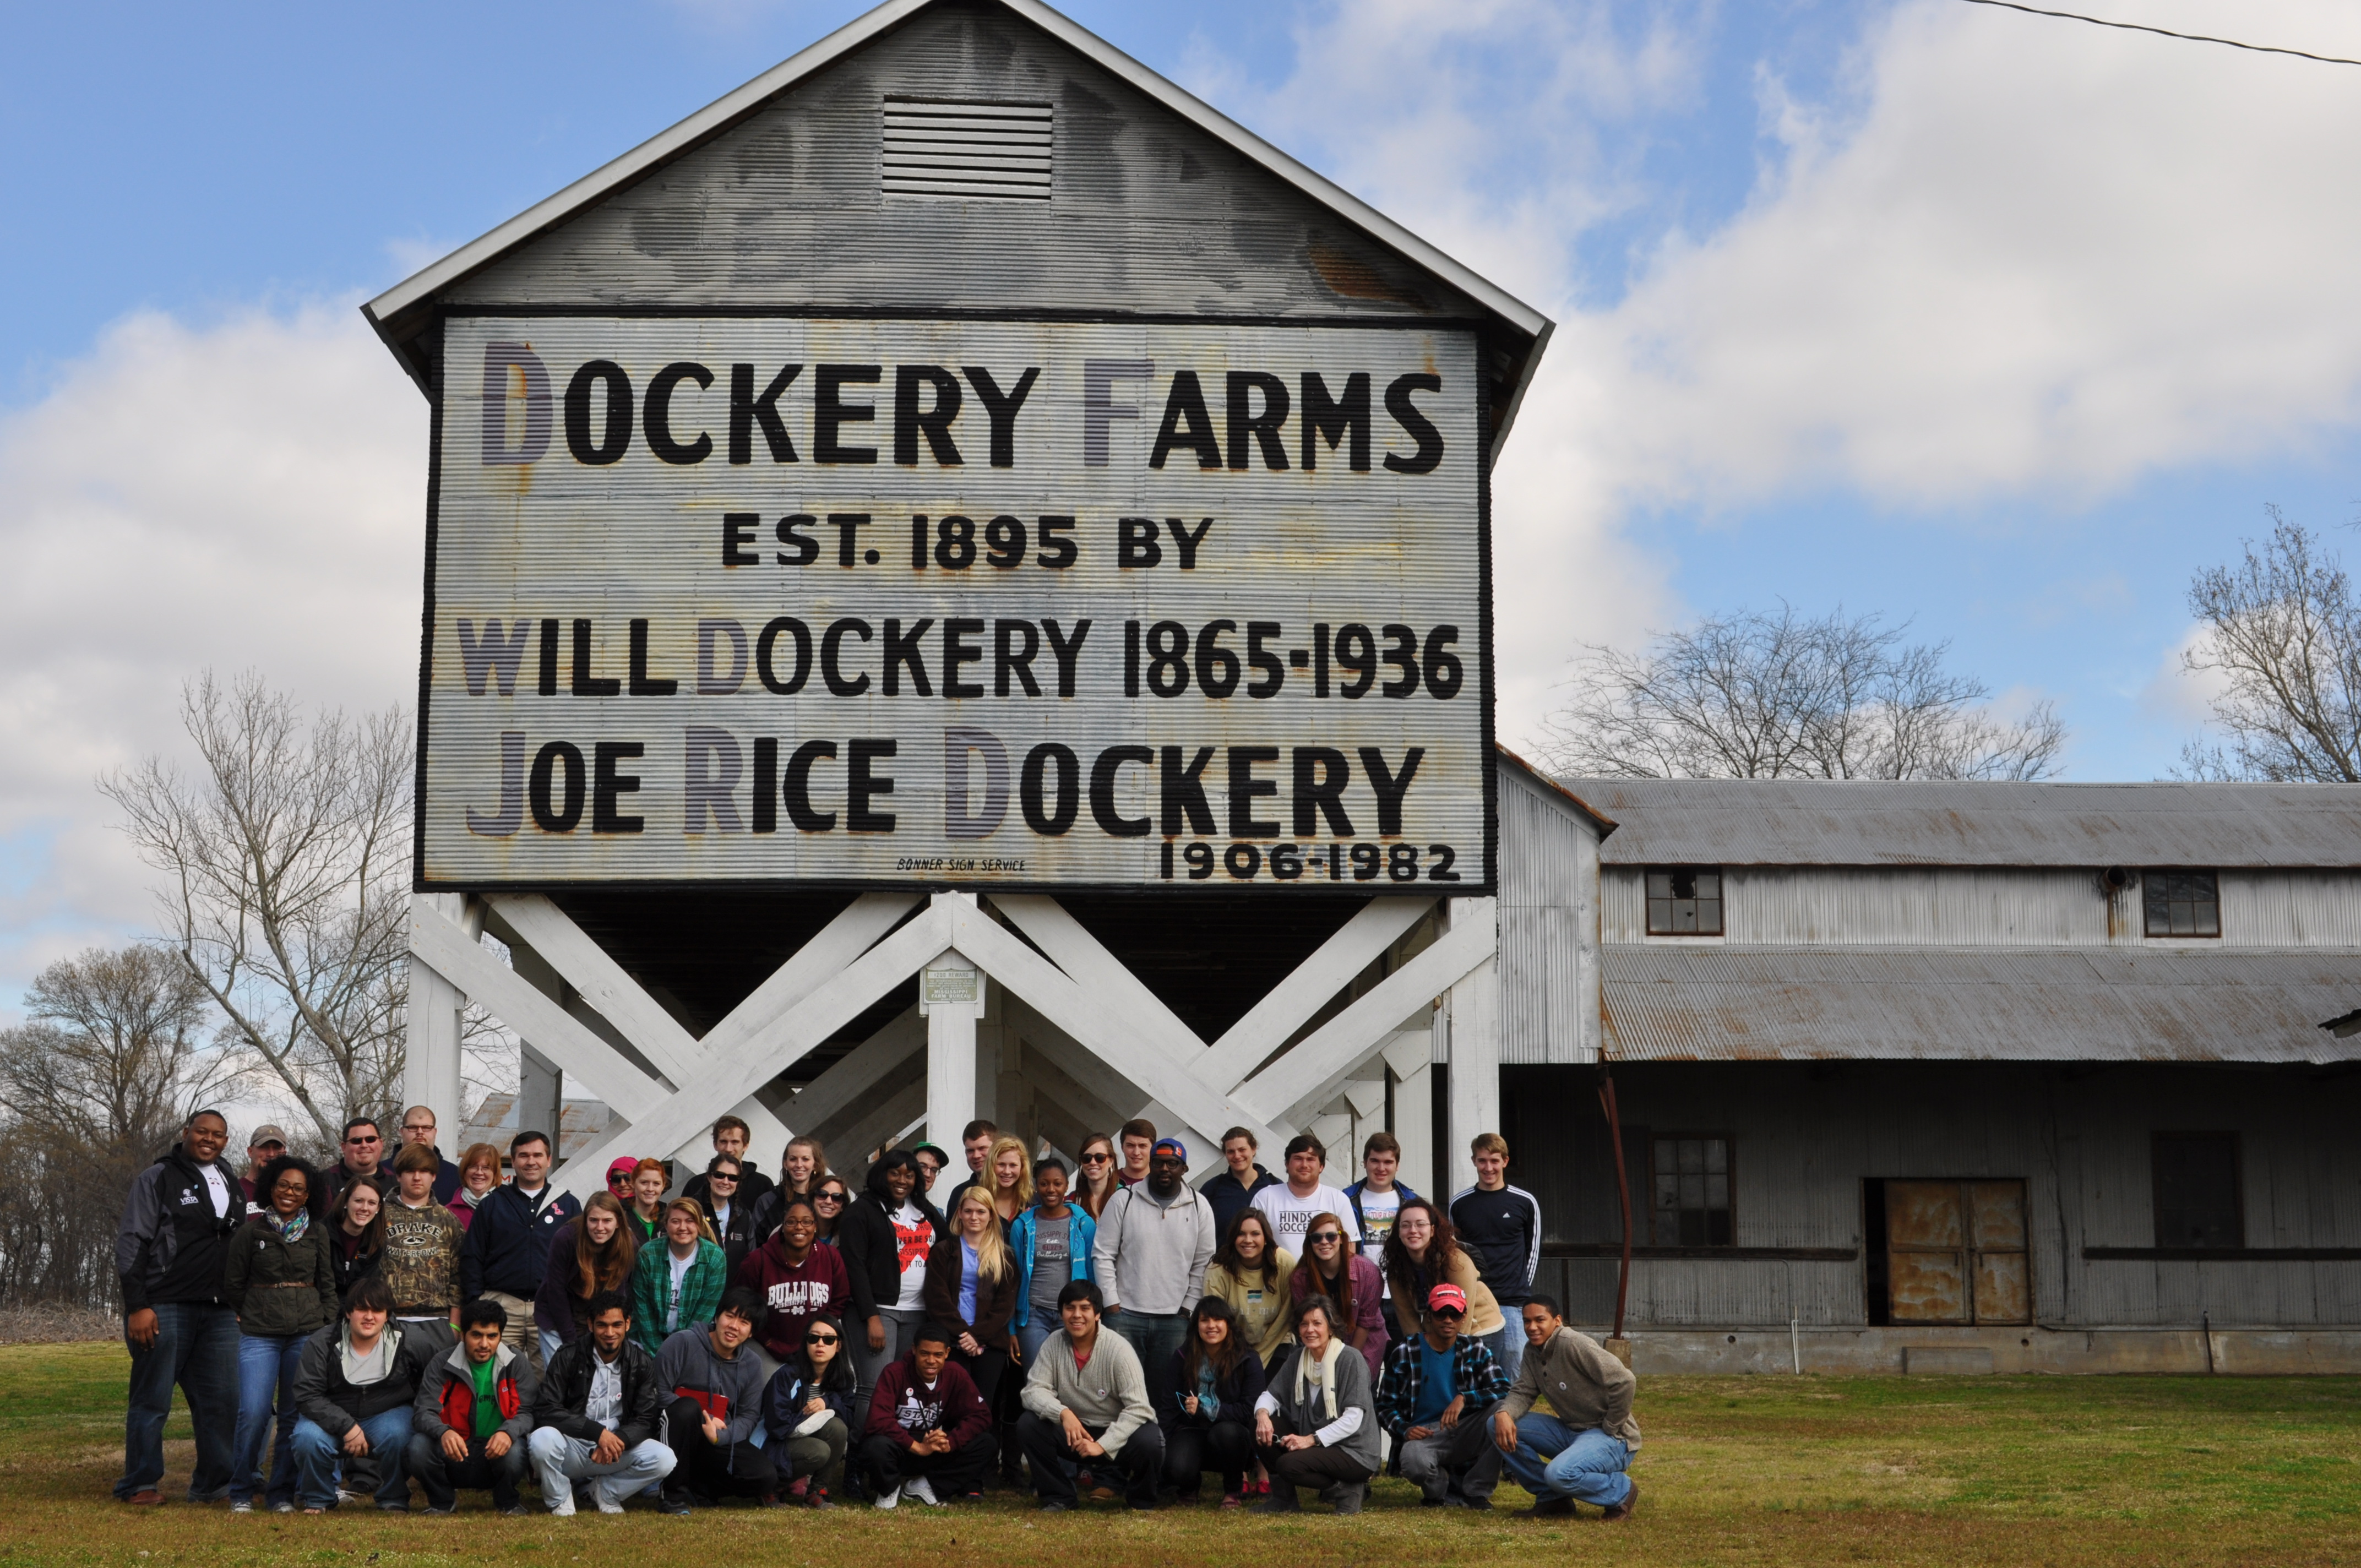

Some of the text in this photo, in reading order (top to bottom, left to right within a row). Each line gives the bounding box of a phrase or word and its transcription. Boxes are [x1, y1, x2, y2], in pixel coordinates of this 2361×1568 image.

[481, 341, 1445, 474] DOCKERY FARMS
[722, 513, 1215, 569] EST. 1895 BY
[456, 616, 1463, 700] WILL DOCKERY 1865-1936
[466, 725, 1426, 840] JOE RICE DOCKERY
[897, 858, 1026, 871] BONNER SIGN SERVICE
[1160, 842, 1461, 881] 1906-1982
[179, 1196, 199, 1204] VISTA
[1280, 1212, 1312, 1223] HINDS
[385, 1222, 443, 1238] DRAKE
[1279, 1222, 1310, 1232] SOCCE
[899, 1236, 912, 1244] VER
[1036, 1231, 1062, 1240] SISSIPPI
[899, 1247, 926, 1256] SISSIPPI
[768, 1281, 829, 1306] BULLDOGS
[775, 1300, 806, 1309] MISSISSIPPI
